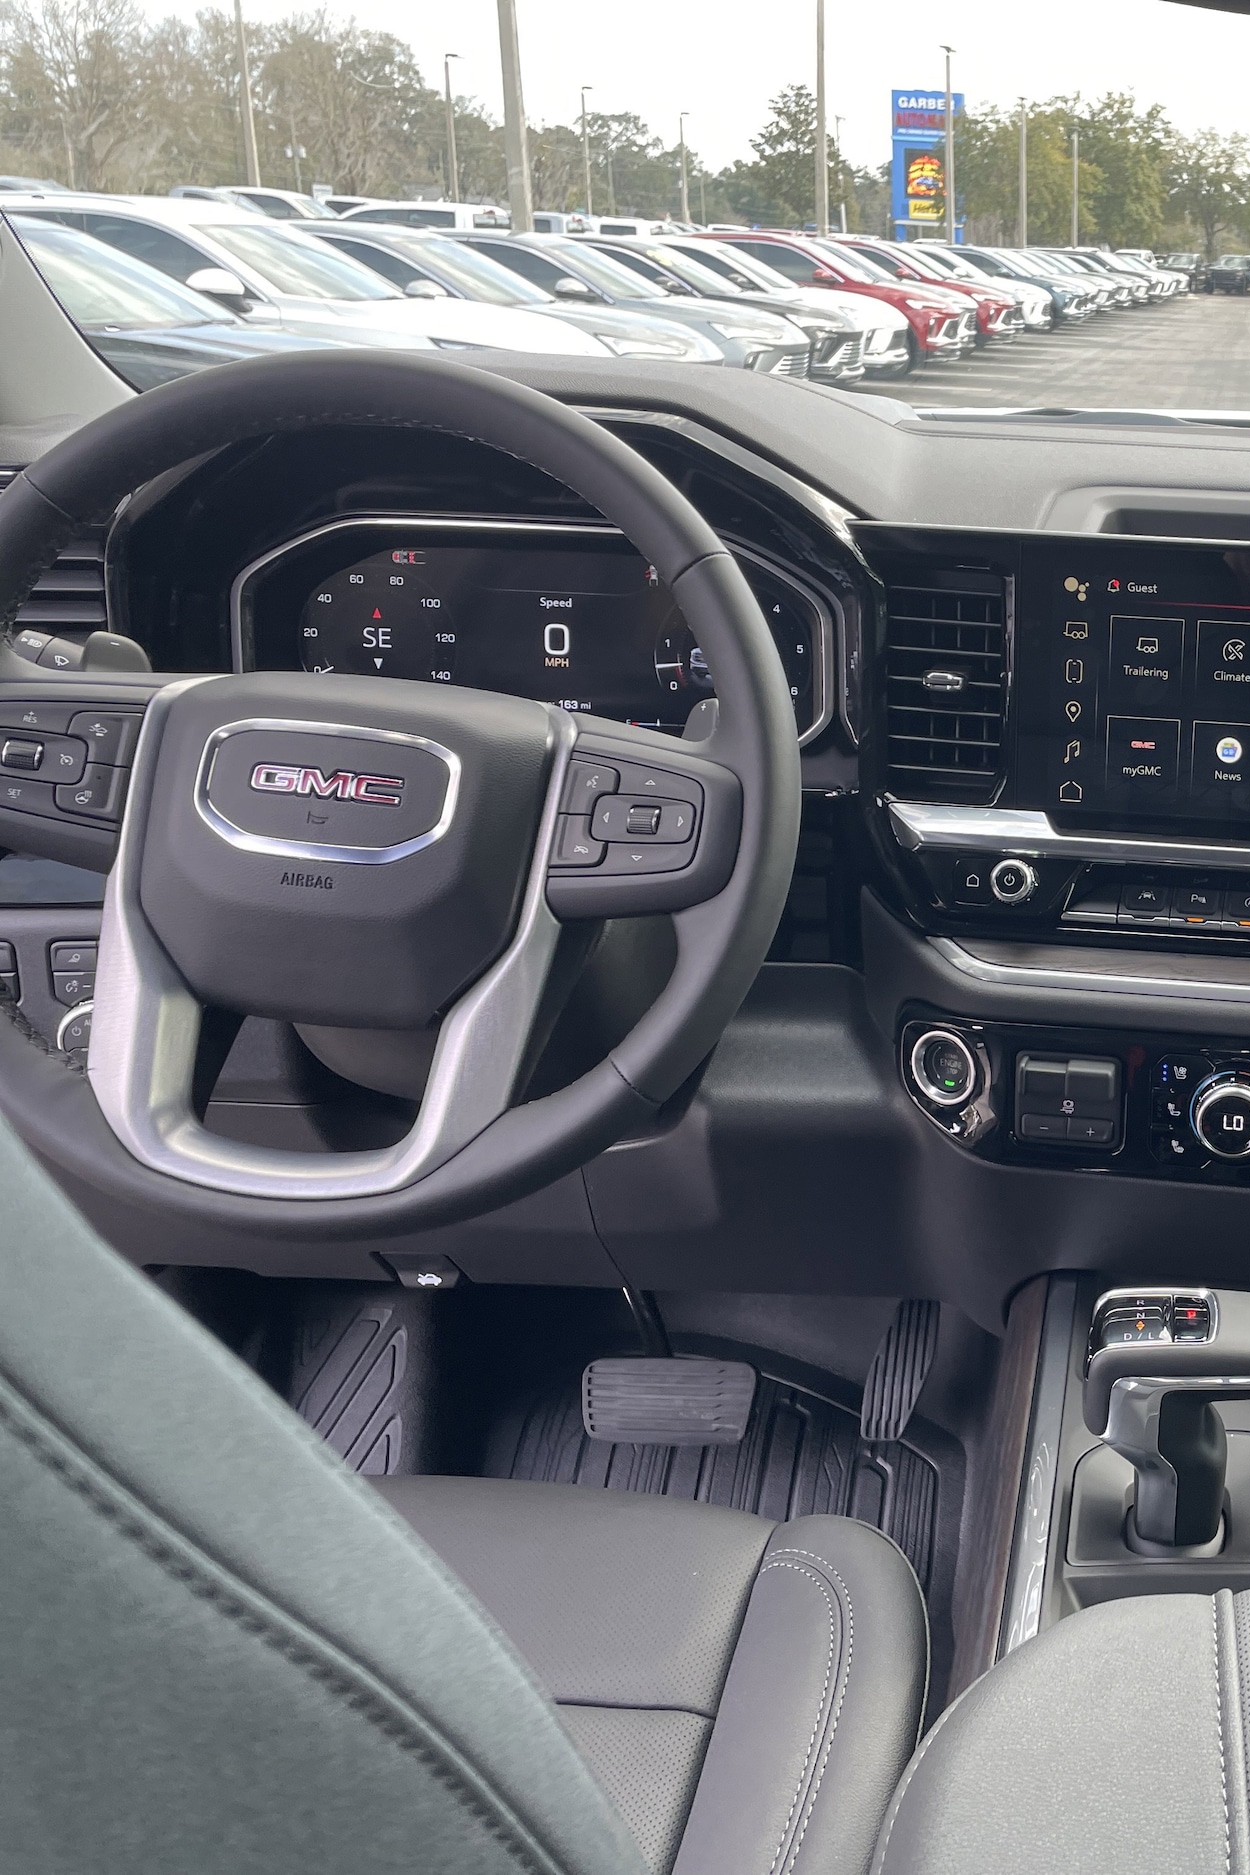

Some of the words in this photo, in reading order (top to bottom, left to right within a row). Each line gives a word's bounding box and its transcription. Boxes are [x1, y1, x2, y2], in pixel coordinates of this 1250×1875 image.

[349, 574, 364, 584] 60
[389, 576, 404, 586] 80
[1127, 582, 1158, 594] Guest
[317, 593, 332, 603] 40
[420, 598, 441, 608] 100
[540, 596, 573, 609] Speed
[772, 604, 781, 613] 4
[303, 627, 318, 637] 20
[362, 626, 392, 648] SE
[435, 633, 456, 643] 120
[544, 623, 570, 655] 0
[664, 638, 671, 648] 1
[796, 644, 804, 654] 5
[544, 657, 570, 667] MPH
[430, 671, 451, 680] 140
[1123, 664, 1169, 680] Trailering
[669, 681, 678, 690] 0
[790, 687, 798, 696] 6
[558, 700, 578, 709] 163
[580, 701, 591, 710] mi
[23, 714, 37, 724] RES
[1131, 740, 1156, 750] GMC
[1122, 765, 1162, 777] myGMC
[1214, 770, 1242, 782] News
[251, 763, 403, 804] GMC
[7, 788, 22, 797] SET
[280, 872, 334, 889] AIRBAG
[1223, 1114, 1244, 1131] LO
[1187, 1310, 1196, 1319] P
[1123, 1332, 1133, 1341] D
[1148, 1332, 1155, 1340] L
